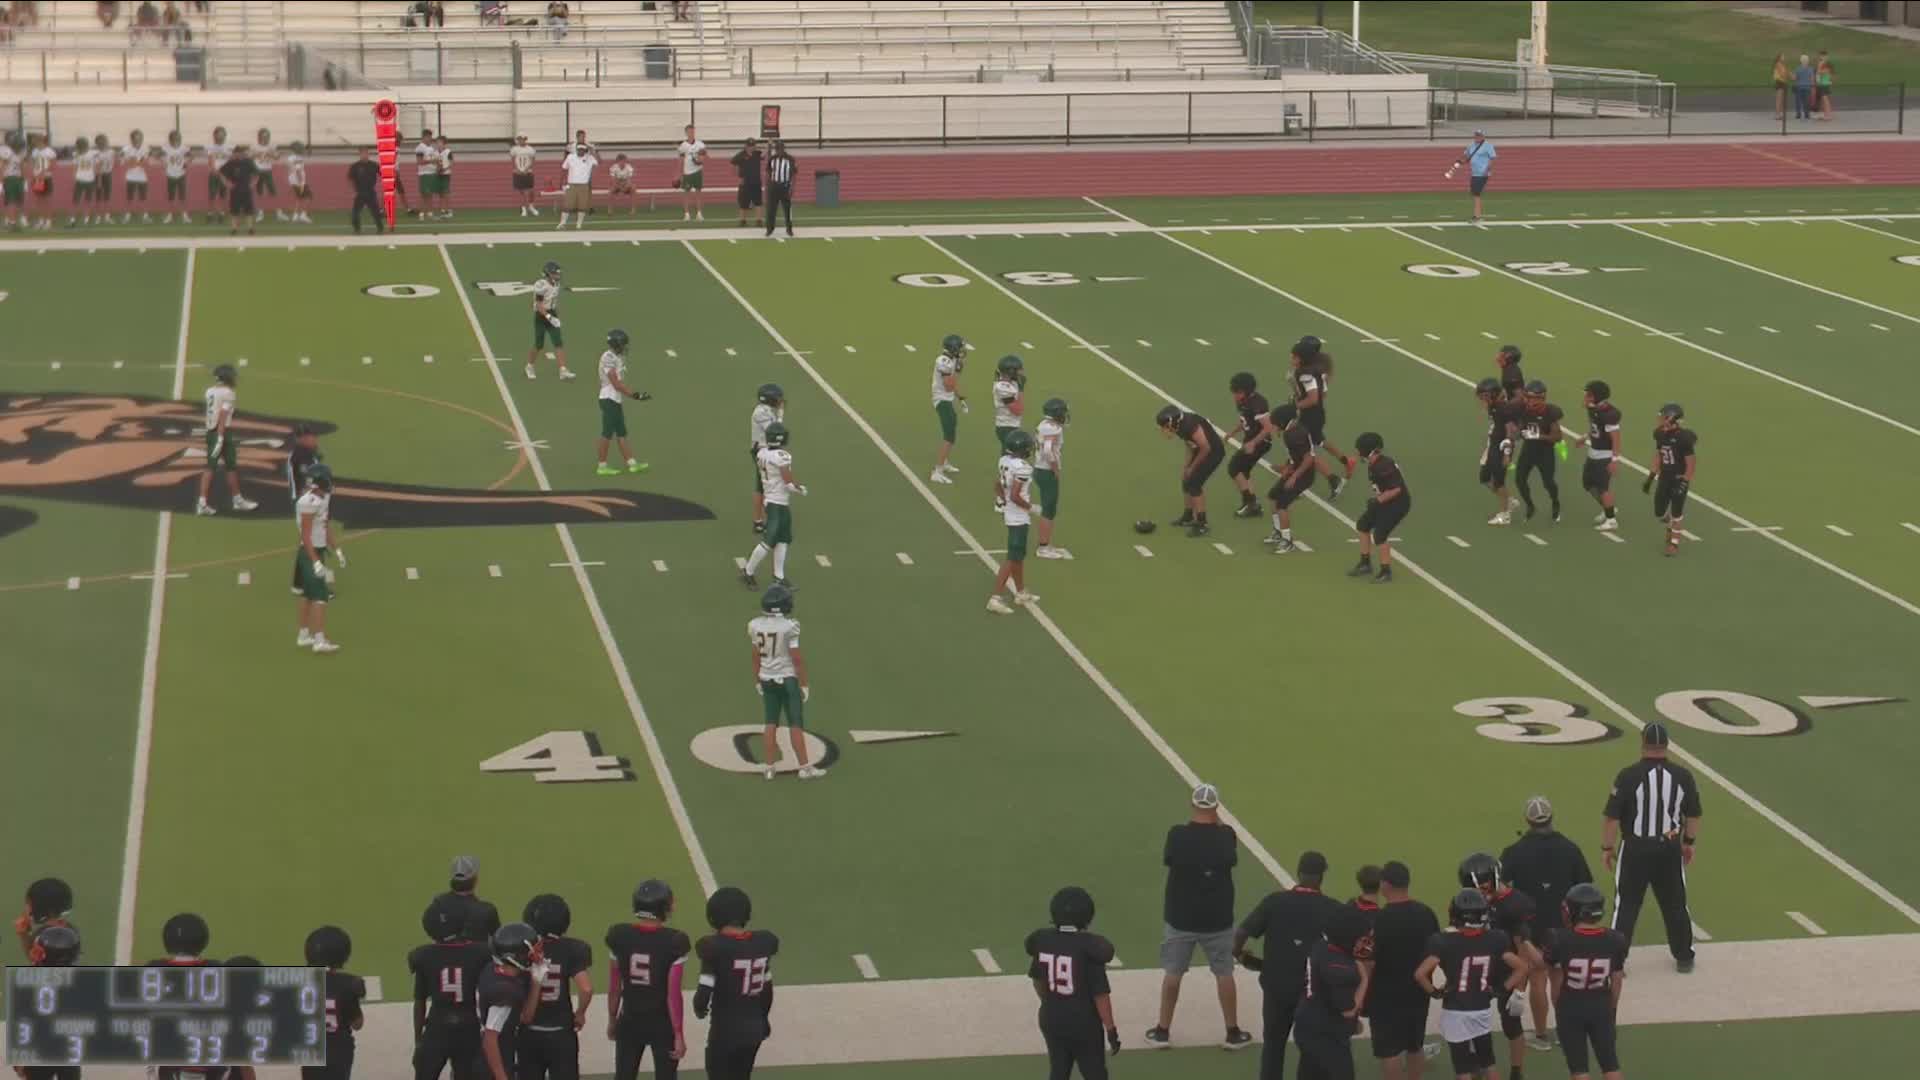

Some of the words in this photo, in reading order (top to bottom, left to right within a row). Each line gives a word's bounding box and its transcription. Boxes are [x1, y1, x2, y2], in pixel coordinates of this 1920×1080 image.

[757, 631, 777, 657] 27
[440, 967, 463, 1003] 4
[630, 952, 650, 985] 5
[733, 957, 769, 995] 73
[1038, 952, 1073, 995] 79
[1458, 955, 1492, 993] 17
[1567, 958, 1611, 990] 33
